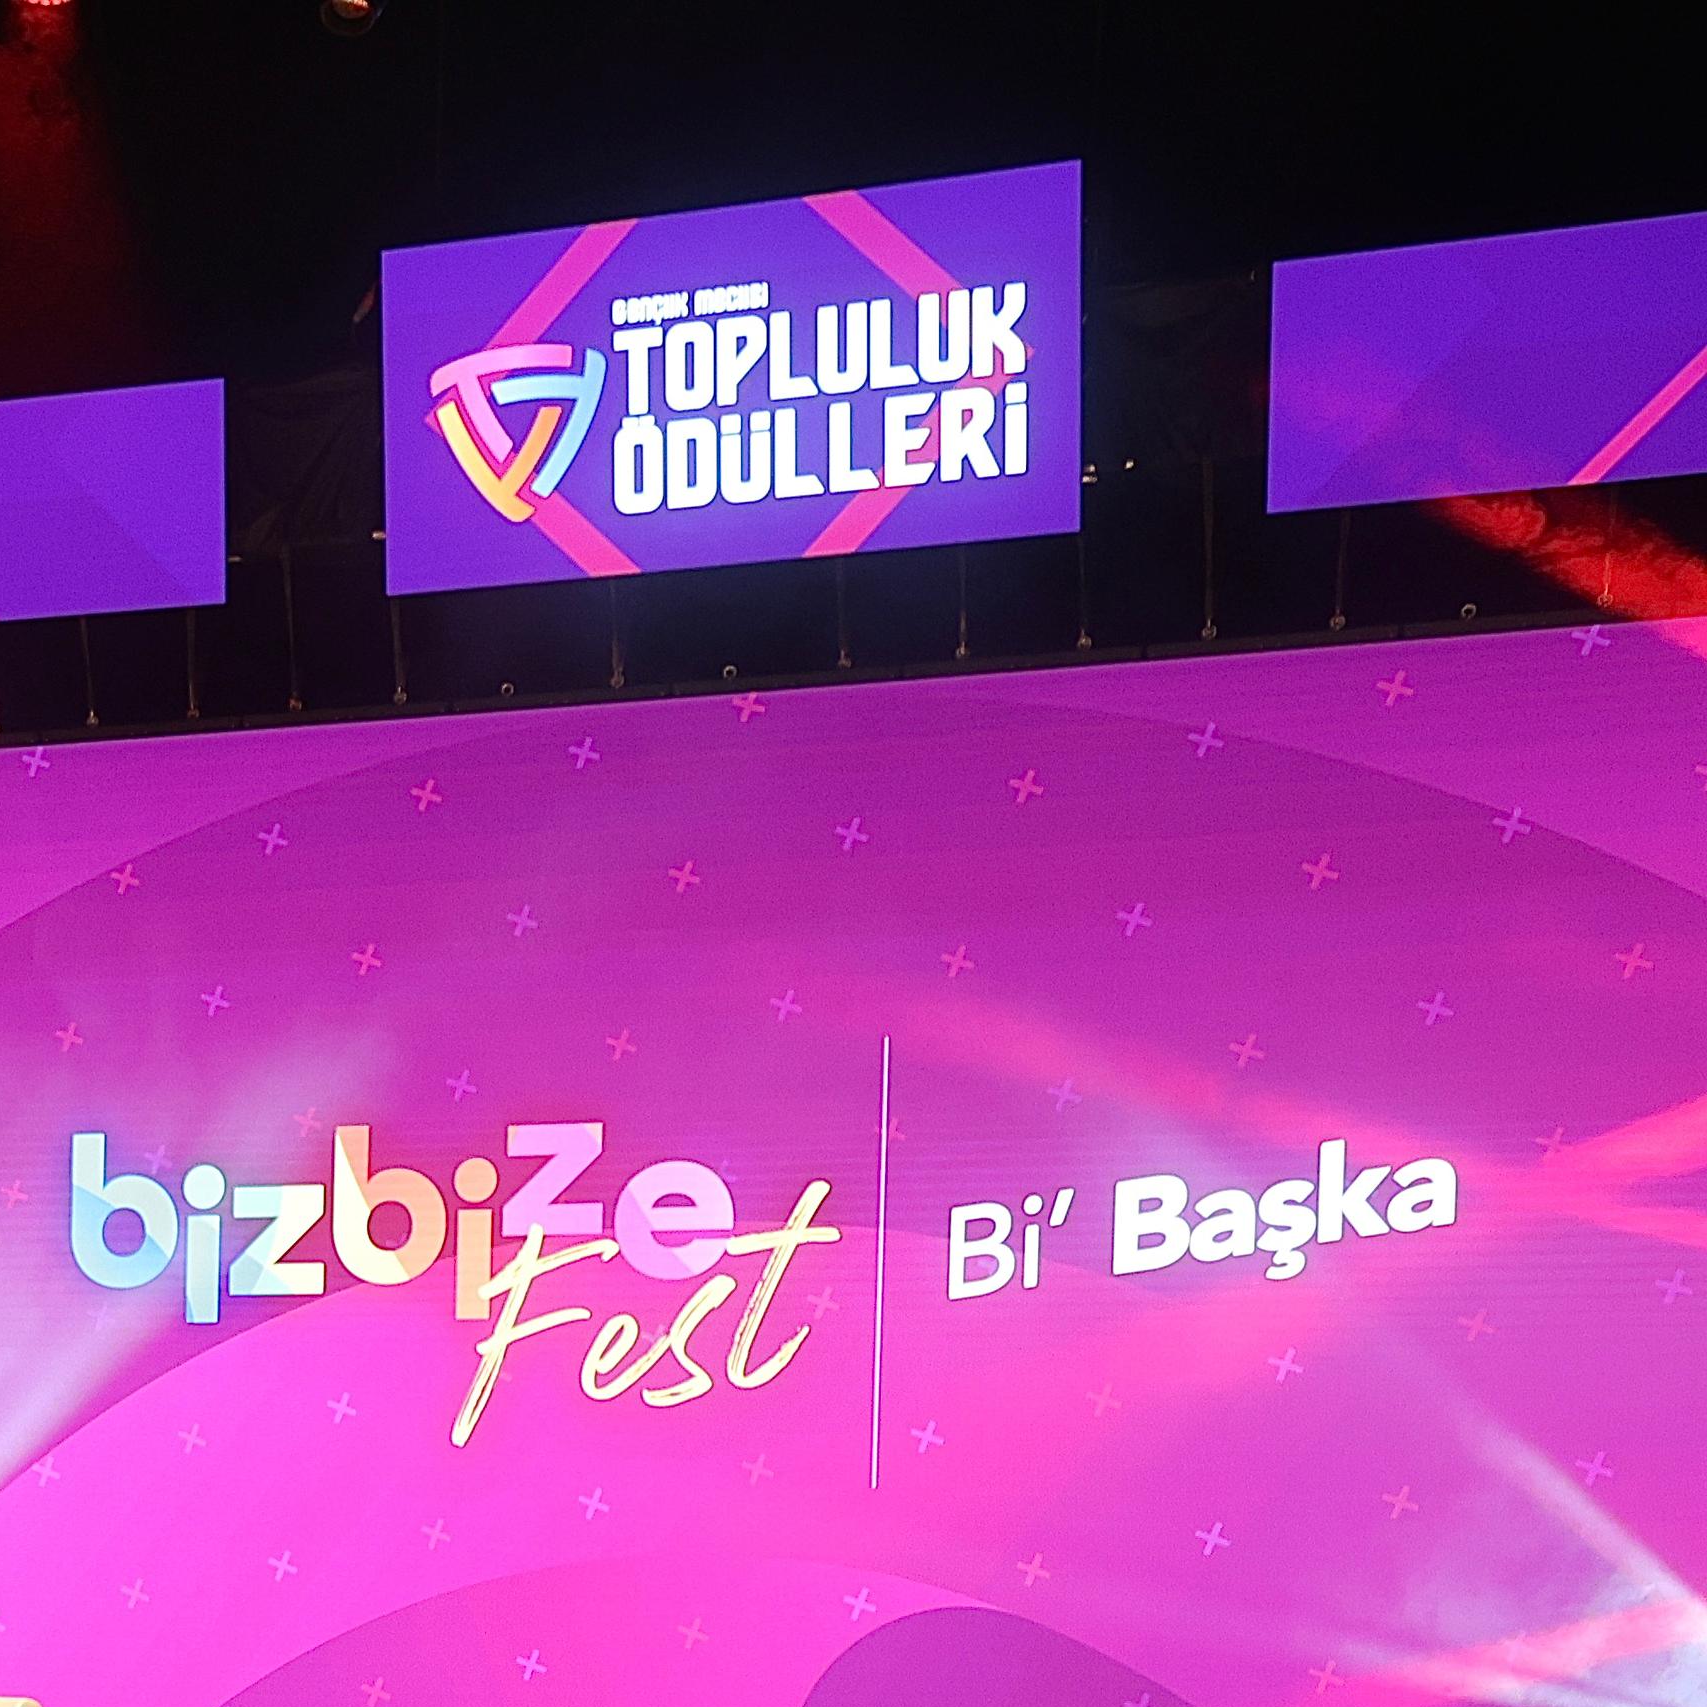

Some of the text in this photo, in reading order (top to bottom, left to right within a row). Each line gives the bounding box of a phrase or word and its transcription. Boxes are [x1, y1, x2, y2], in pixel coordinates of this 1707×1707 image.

[613, 282, 1026, 416] TOPLULUK
[613, 382, 1027, 515] ÖDÜLLERİ
[1112, 1139, 1458, 1281] Başka
[450, 1178, 842, 1449] Fest
